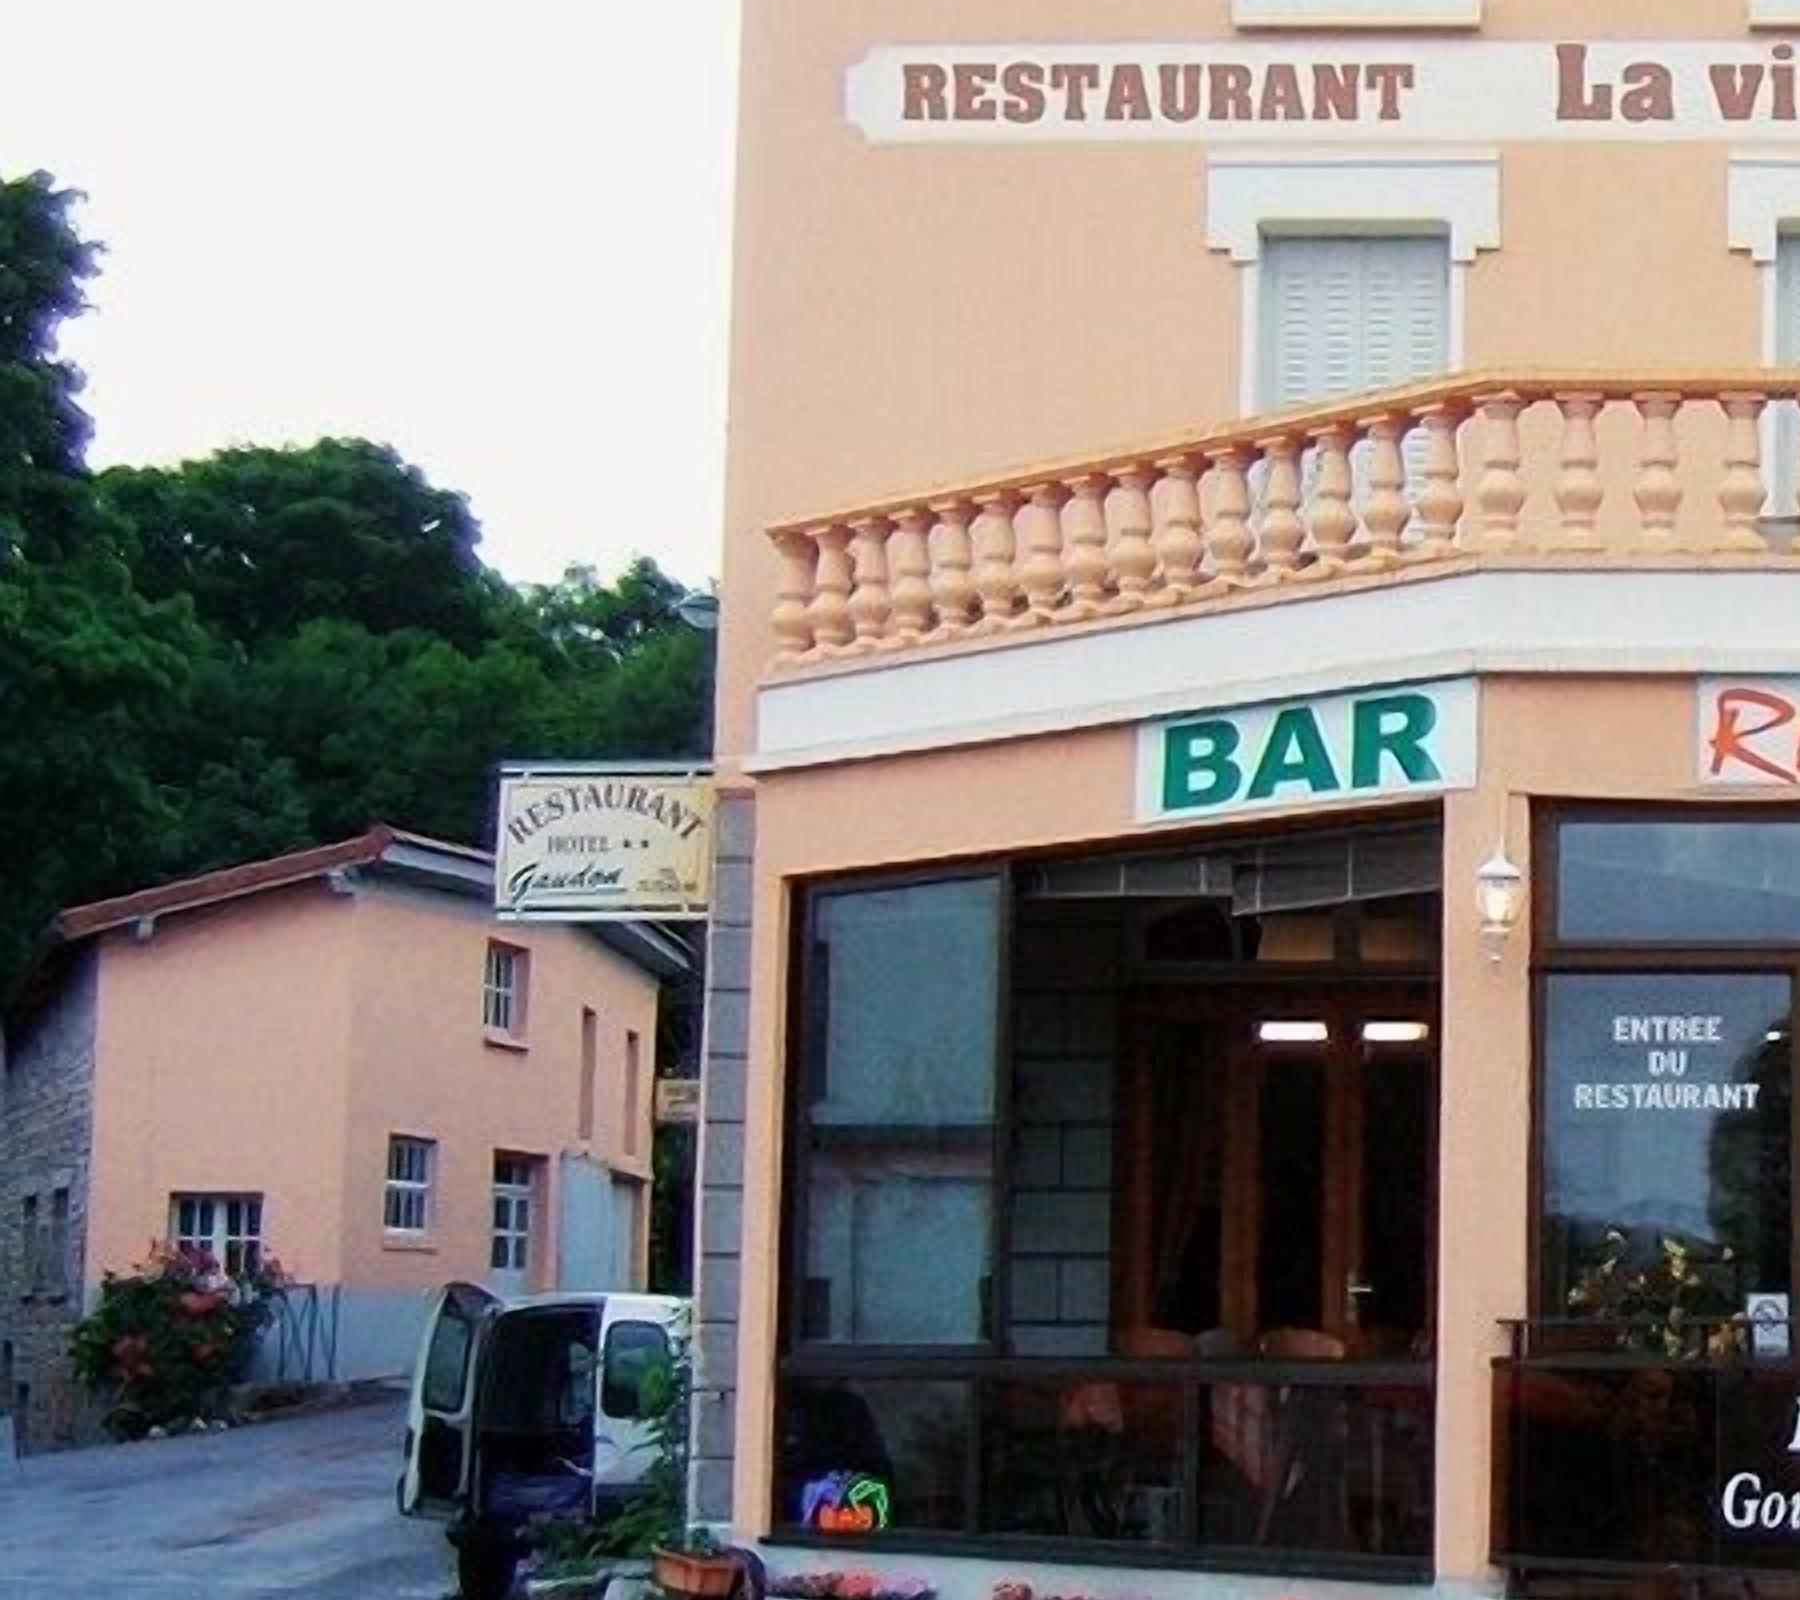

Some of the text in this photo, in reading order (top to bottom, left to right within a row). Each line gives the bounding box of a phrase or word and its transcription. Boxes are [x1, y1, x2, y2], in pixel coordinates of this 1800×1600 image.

[902, 61, 1415, 124] RESTAURANT
[1555, 43, 1675, 122] La
[1162, 691, 1442, 812] BAR
[506, 783, 704, 844] RESTAURANT
[1613, 1015, 1723, 1043] ENTREE
[1648, 1050, 1688, 1077] DU
[1574, 1082, 1761, 1110] RESTAURANT
